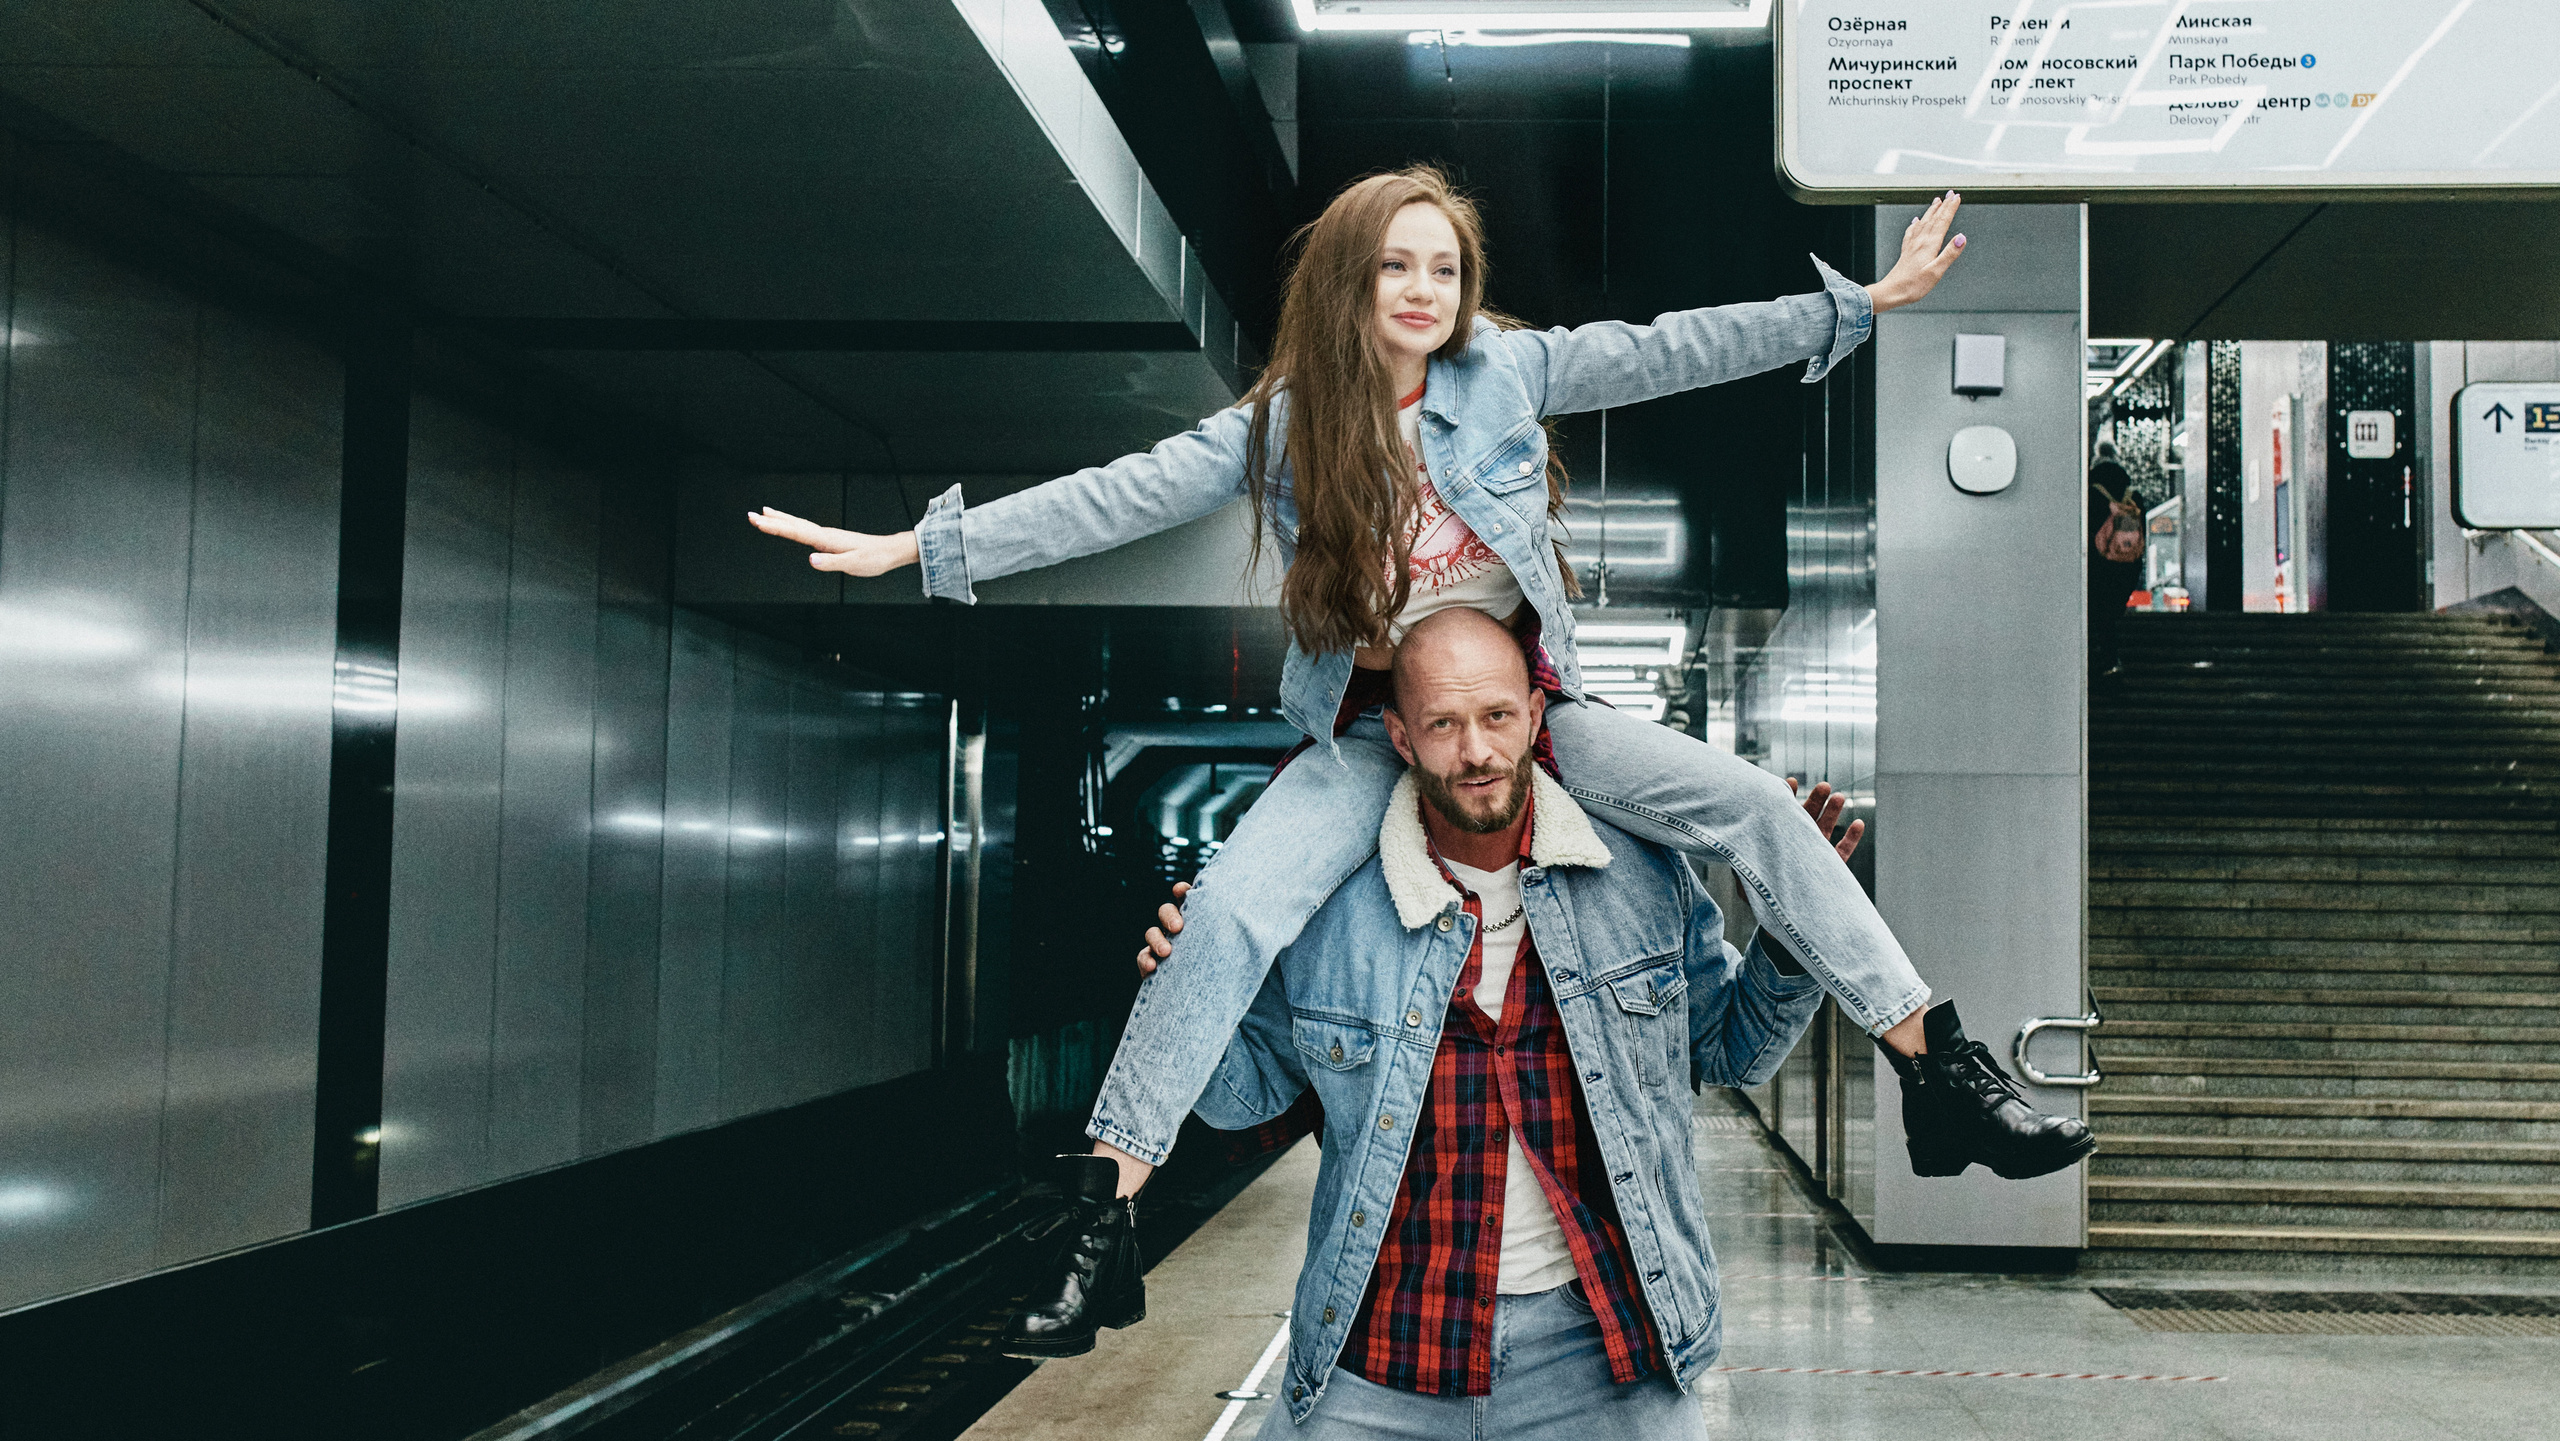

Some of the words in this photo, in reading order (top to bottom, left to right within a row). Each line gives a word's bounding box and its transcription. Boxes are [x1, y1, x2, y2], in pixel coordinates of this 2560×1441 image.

[1828, 17, 1907, 34] Озёрная
[1990, 16, 2070, 30] Раени
[1828, 37, 1893, 49] Ozyornaya
[1990, 35, 2041, 46] Renk
[1828, 57, 1957, 74] Мичуринский
[1999, 55, 2138, 70] омносовский
[2169, 54, 2216, 71] Парк
[2222, 54, 2296, 69] Победы
[2303, 55, 2314, 67] 3
[1828, 79, 1913, 92] проспект
[2169, 74, 2197, 85] Park
[2201, 74, 2248, 86] Pobedy
[1828, 95, 1908, 107] Michurinskiy
[1912, 95, 1967, 107] Prospekt
[2169, 99, 2243, 111] елово
[2257, 97, 2311, 111] центр
[2169, 113, 2219, 126] Delovoy
[2223, 113, 2261, 124] Tntr
